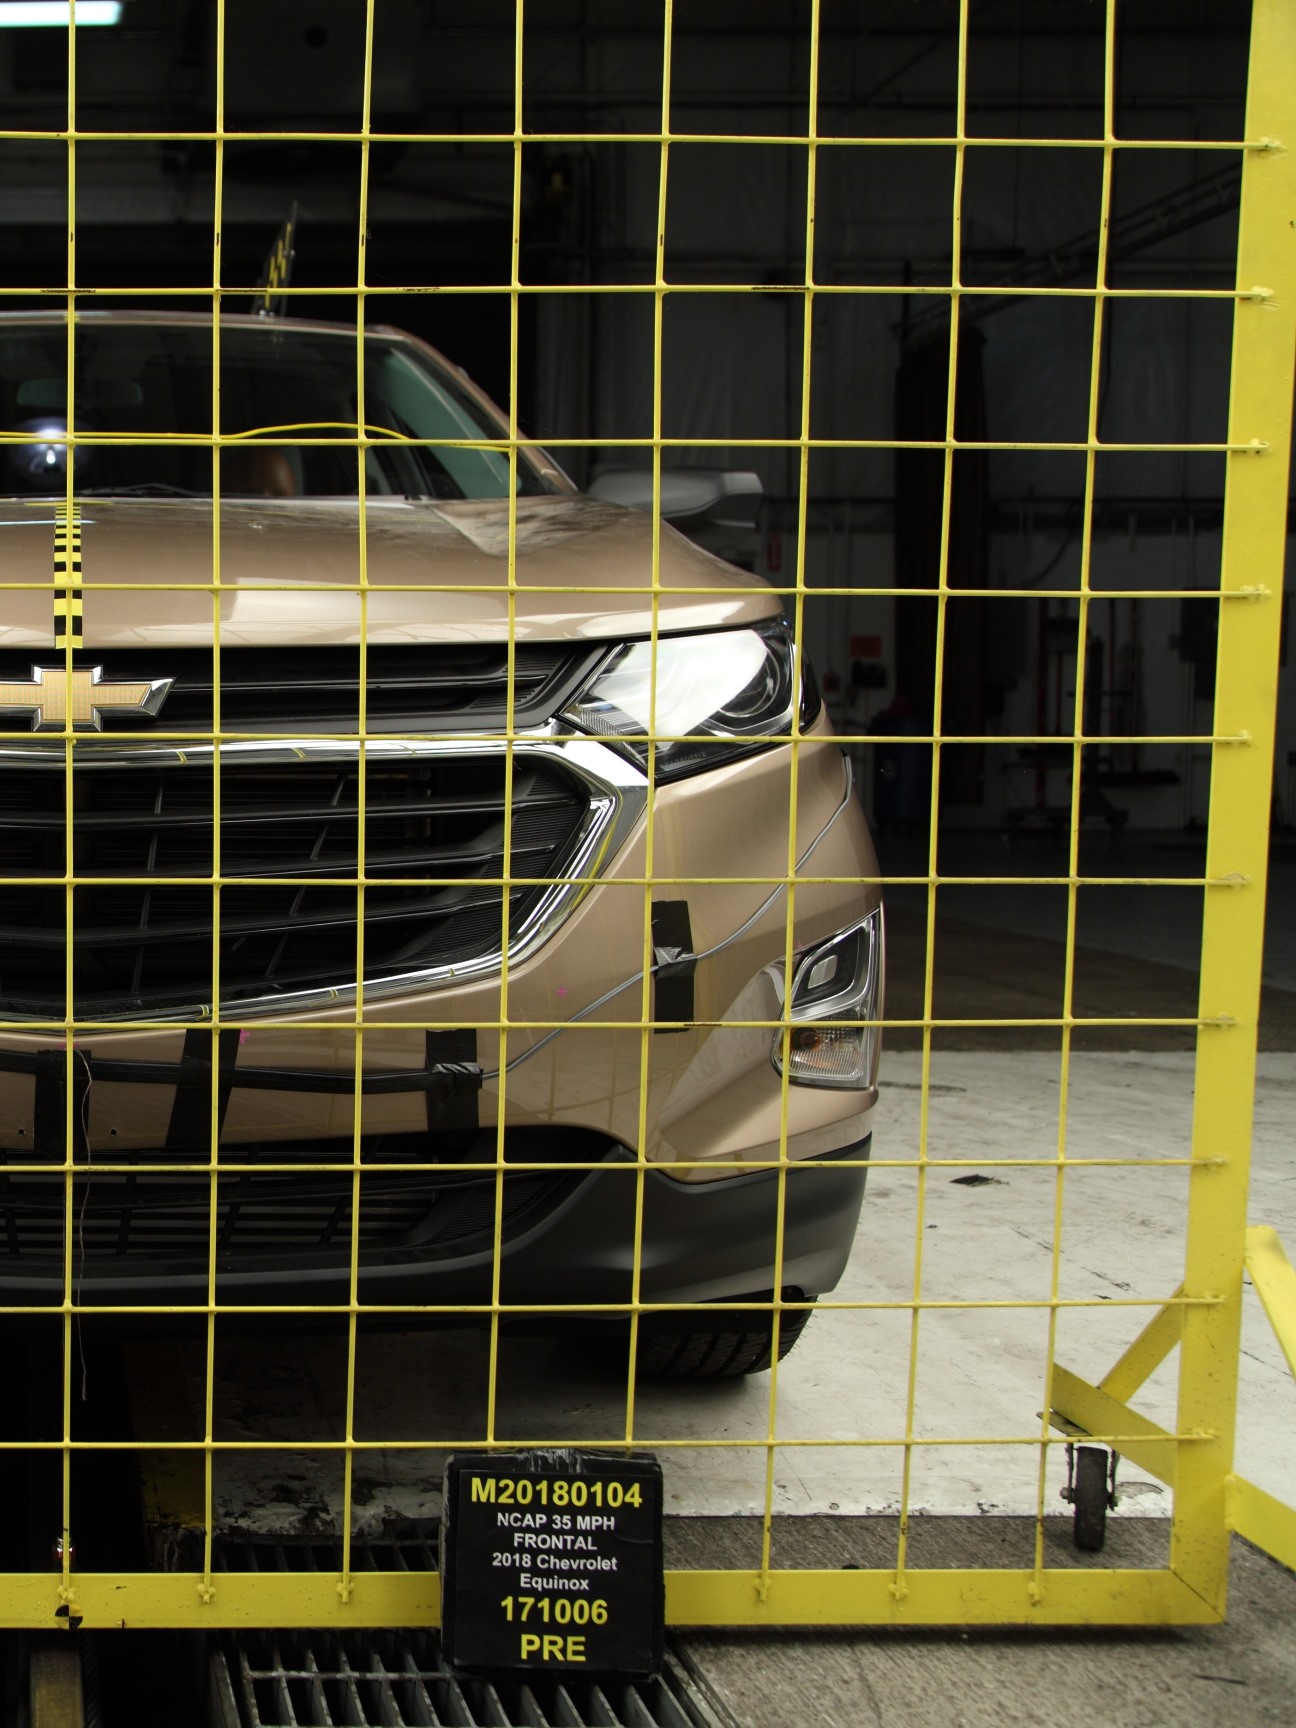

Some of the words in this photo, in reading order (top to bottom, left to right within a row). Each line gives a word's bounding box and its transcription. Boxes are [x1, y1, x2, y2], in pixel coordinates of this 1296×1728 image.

[471, 1477, 643, 1508] M20180104
[497, 1512, 547, 1529] NCAP
[551, 1514, 572, 1530] 35
[576, 1515, 615, 1531] MPH
[513, 1532, 598, 1551] FRONTAL
[492, 1552, 532, 1568] 2018
[536, 1554, 618, 1571] Chevrolet
[520, 1572, 590, 1592] Equinox
[501, 1595, 608, 1625] 171006
[520, 1633, 586, 1662] PRE
